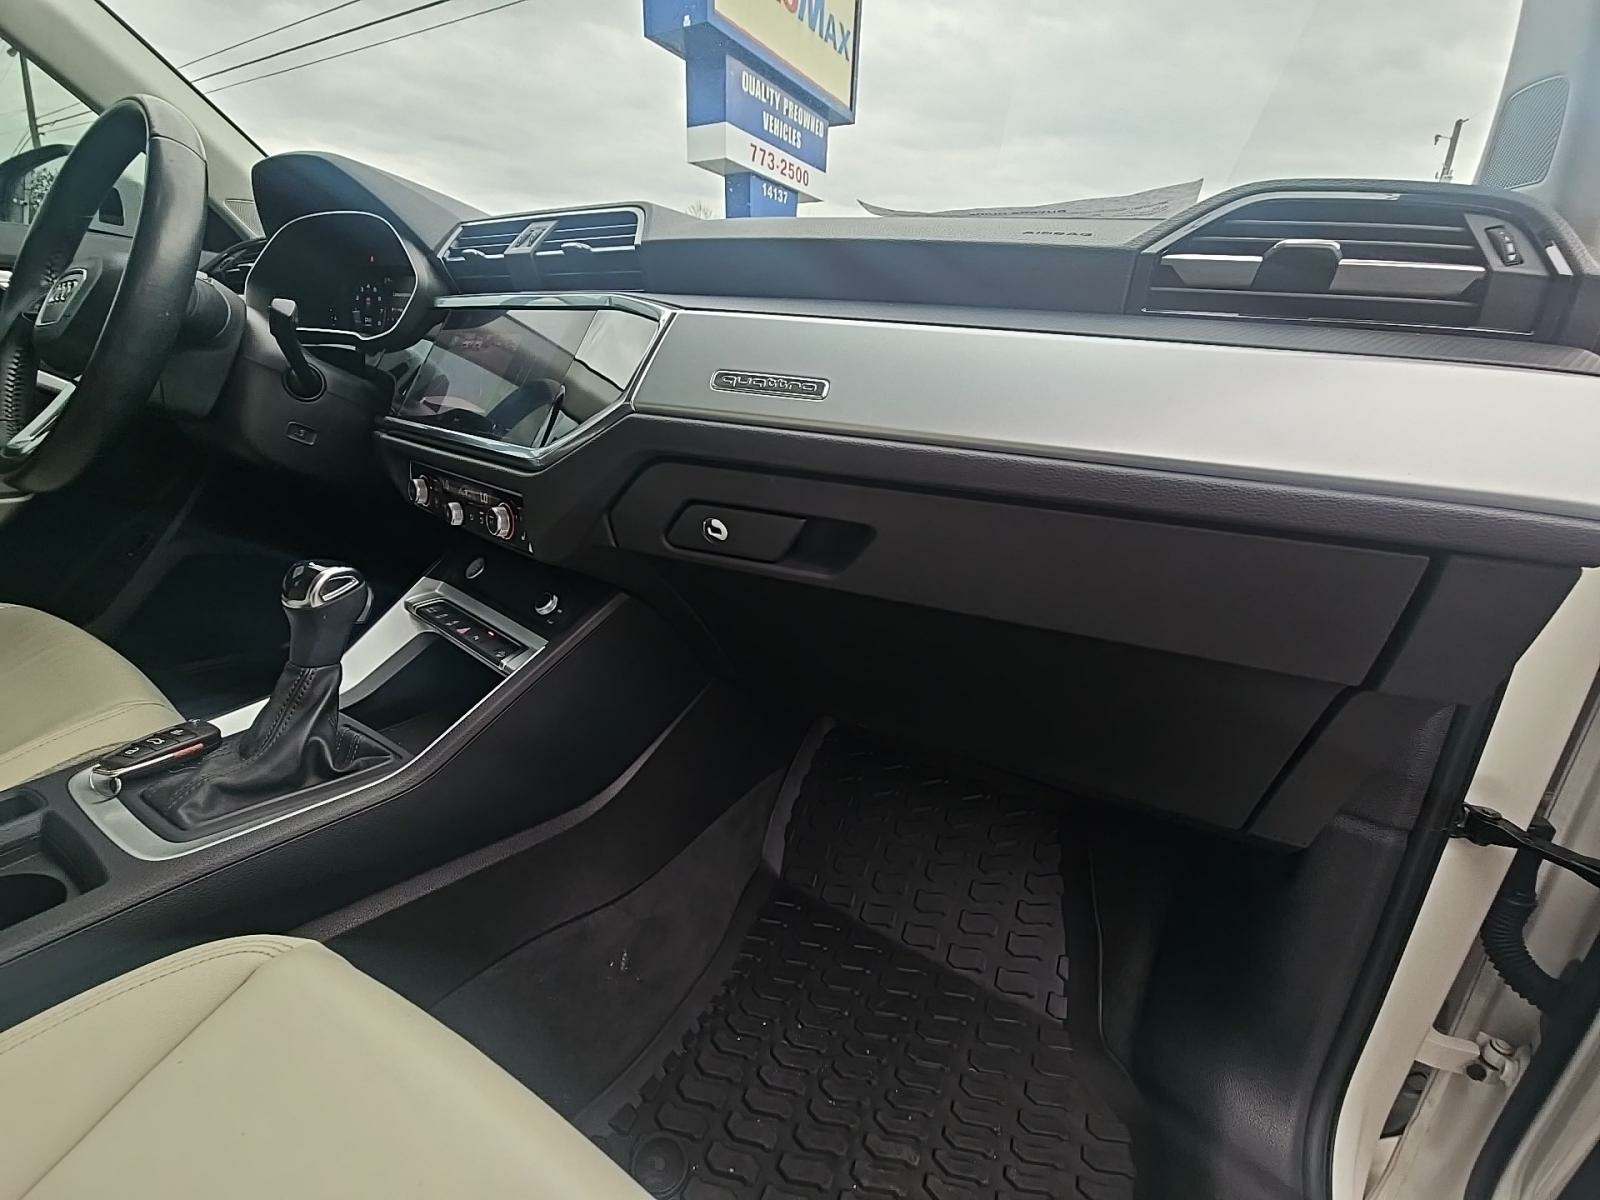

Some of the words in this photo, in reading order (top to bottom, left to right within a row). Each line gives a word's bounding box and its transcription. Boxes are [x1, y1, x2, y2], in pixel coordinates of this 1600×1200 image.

[742, 70, 781, 111] QUALITY
[783, 97, 824, 138] PREOWNED
[762, 110, 802, 149] VEHICLES
[762, 182, 788, 204] 14137
